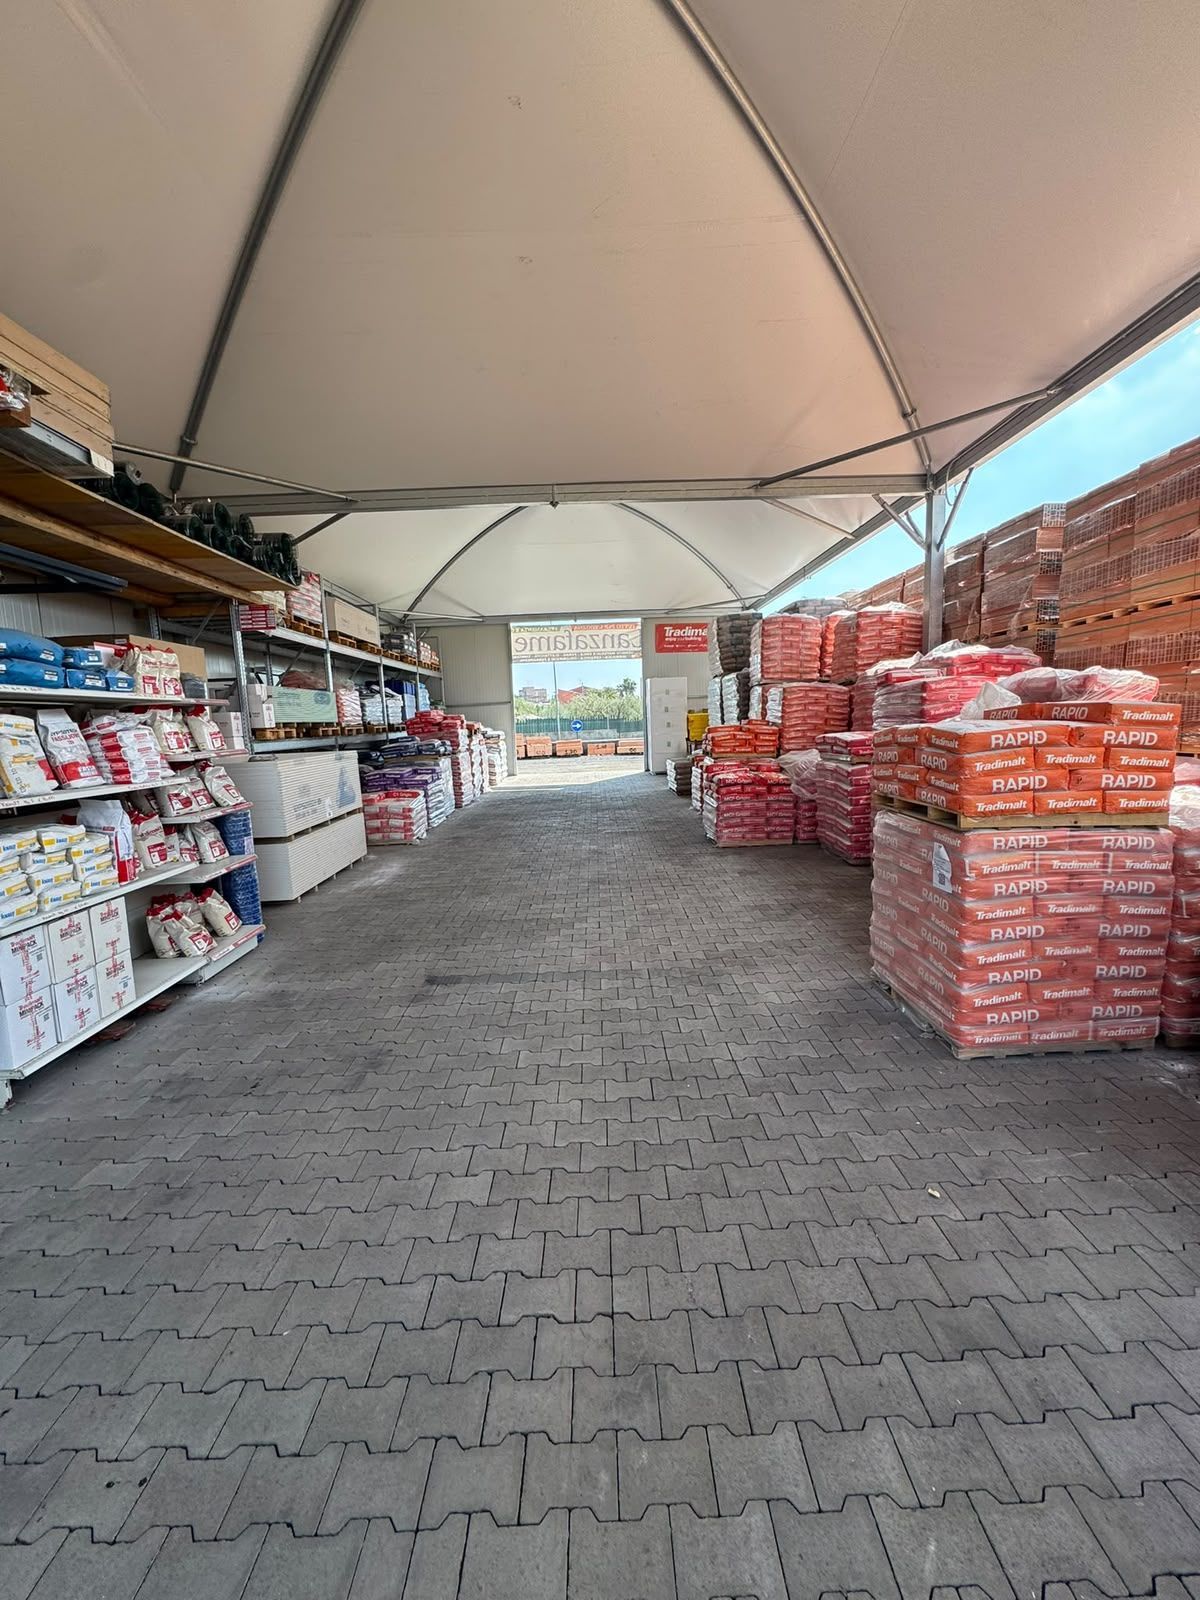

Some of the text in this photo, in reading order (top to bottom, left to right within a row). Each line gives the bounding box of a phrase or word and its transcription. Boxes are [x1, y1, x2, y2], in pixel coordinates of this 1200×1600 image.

[664, 626, 708, 637] Tradima
[1052, 706, 1088, 720] RAPID
[1122, 710, 1174, 721] Tradimalt
[931, 735, 958, 748] Tradimalt
[991, 730, 1047, 749] RAPID
[1104, 730, 1158, 746] RAPID
[921, 755, 947, 770] RAPID
[974, 756, 1026, 772] Tradimalt
[1045, 754, 1096, 764] Tradimalt
[1120, 756, 1169, 768] Tradimalt
[931, 776, 959, 791] Tradimalt
[992, 775, 1047, 793] RAPID
[1101, 774, 1156, 788] RAPID
[976, 800, 1028, 812] Tradimalt
[1047, 798, 1098, 809] Tradimalt
[1118, 798, 1169, 809] Tradimalt
[993, 835, 1048, 850] RAPID
[1102, 836, 1155, 850] RAPID
[982, 860, 1032, 874] Tradimalt
[1124, 860, 1172, 870] Tradimalt
[994, 880, 1048, 897] RAPID
[1102, 880, 1156, 894] RAPID
[976, 907, 1026, 920] Tradimalt
[1119, 905, 1166, 915] Tradimalt
[991, 925, 1044, 941] RAPID
[1098, 924, 1151, 937] RAPID
[977, 950, 1026, 965] Tradimalt
[1044, 946, 1092, 956] Tradimalt
[1118, 947, 1164, 956] Tradimalt
[988, 968, 1042, 984] RAPID
[1096, 965, 1147, 978] RAPID
[973, 992, 1022, 1007] Tradimalt
[1043, 987, 1091, 999] Tradimalt
[1113, 988, 1158, 998] Tradimalt
[987, 1009, 1039, 1025] RAPID
[1092, 1005, 1143, 1018] RAPID
